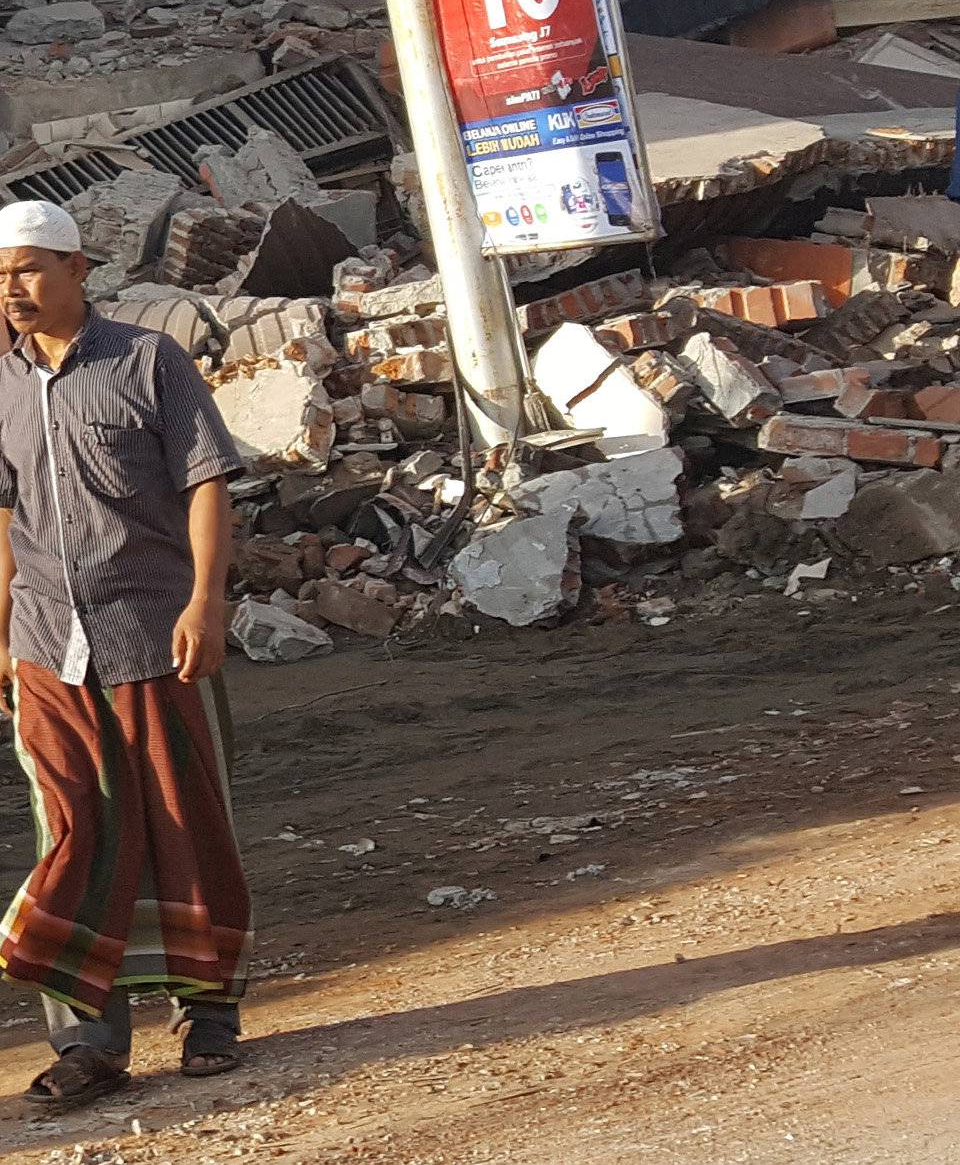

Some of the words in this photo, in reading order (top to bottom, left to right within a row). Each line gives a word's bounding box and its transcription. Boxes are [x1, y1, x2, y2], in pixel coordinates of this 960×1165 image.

[463, 125, 502, 141] BELANJA
[502, 119, 537, 135] ONLINE
[466, 140, 500, 157] LEBIH
[500, 134, 540, 151] MUDAH
